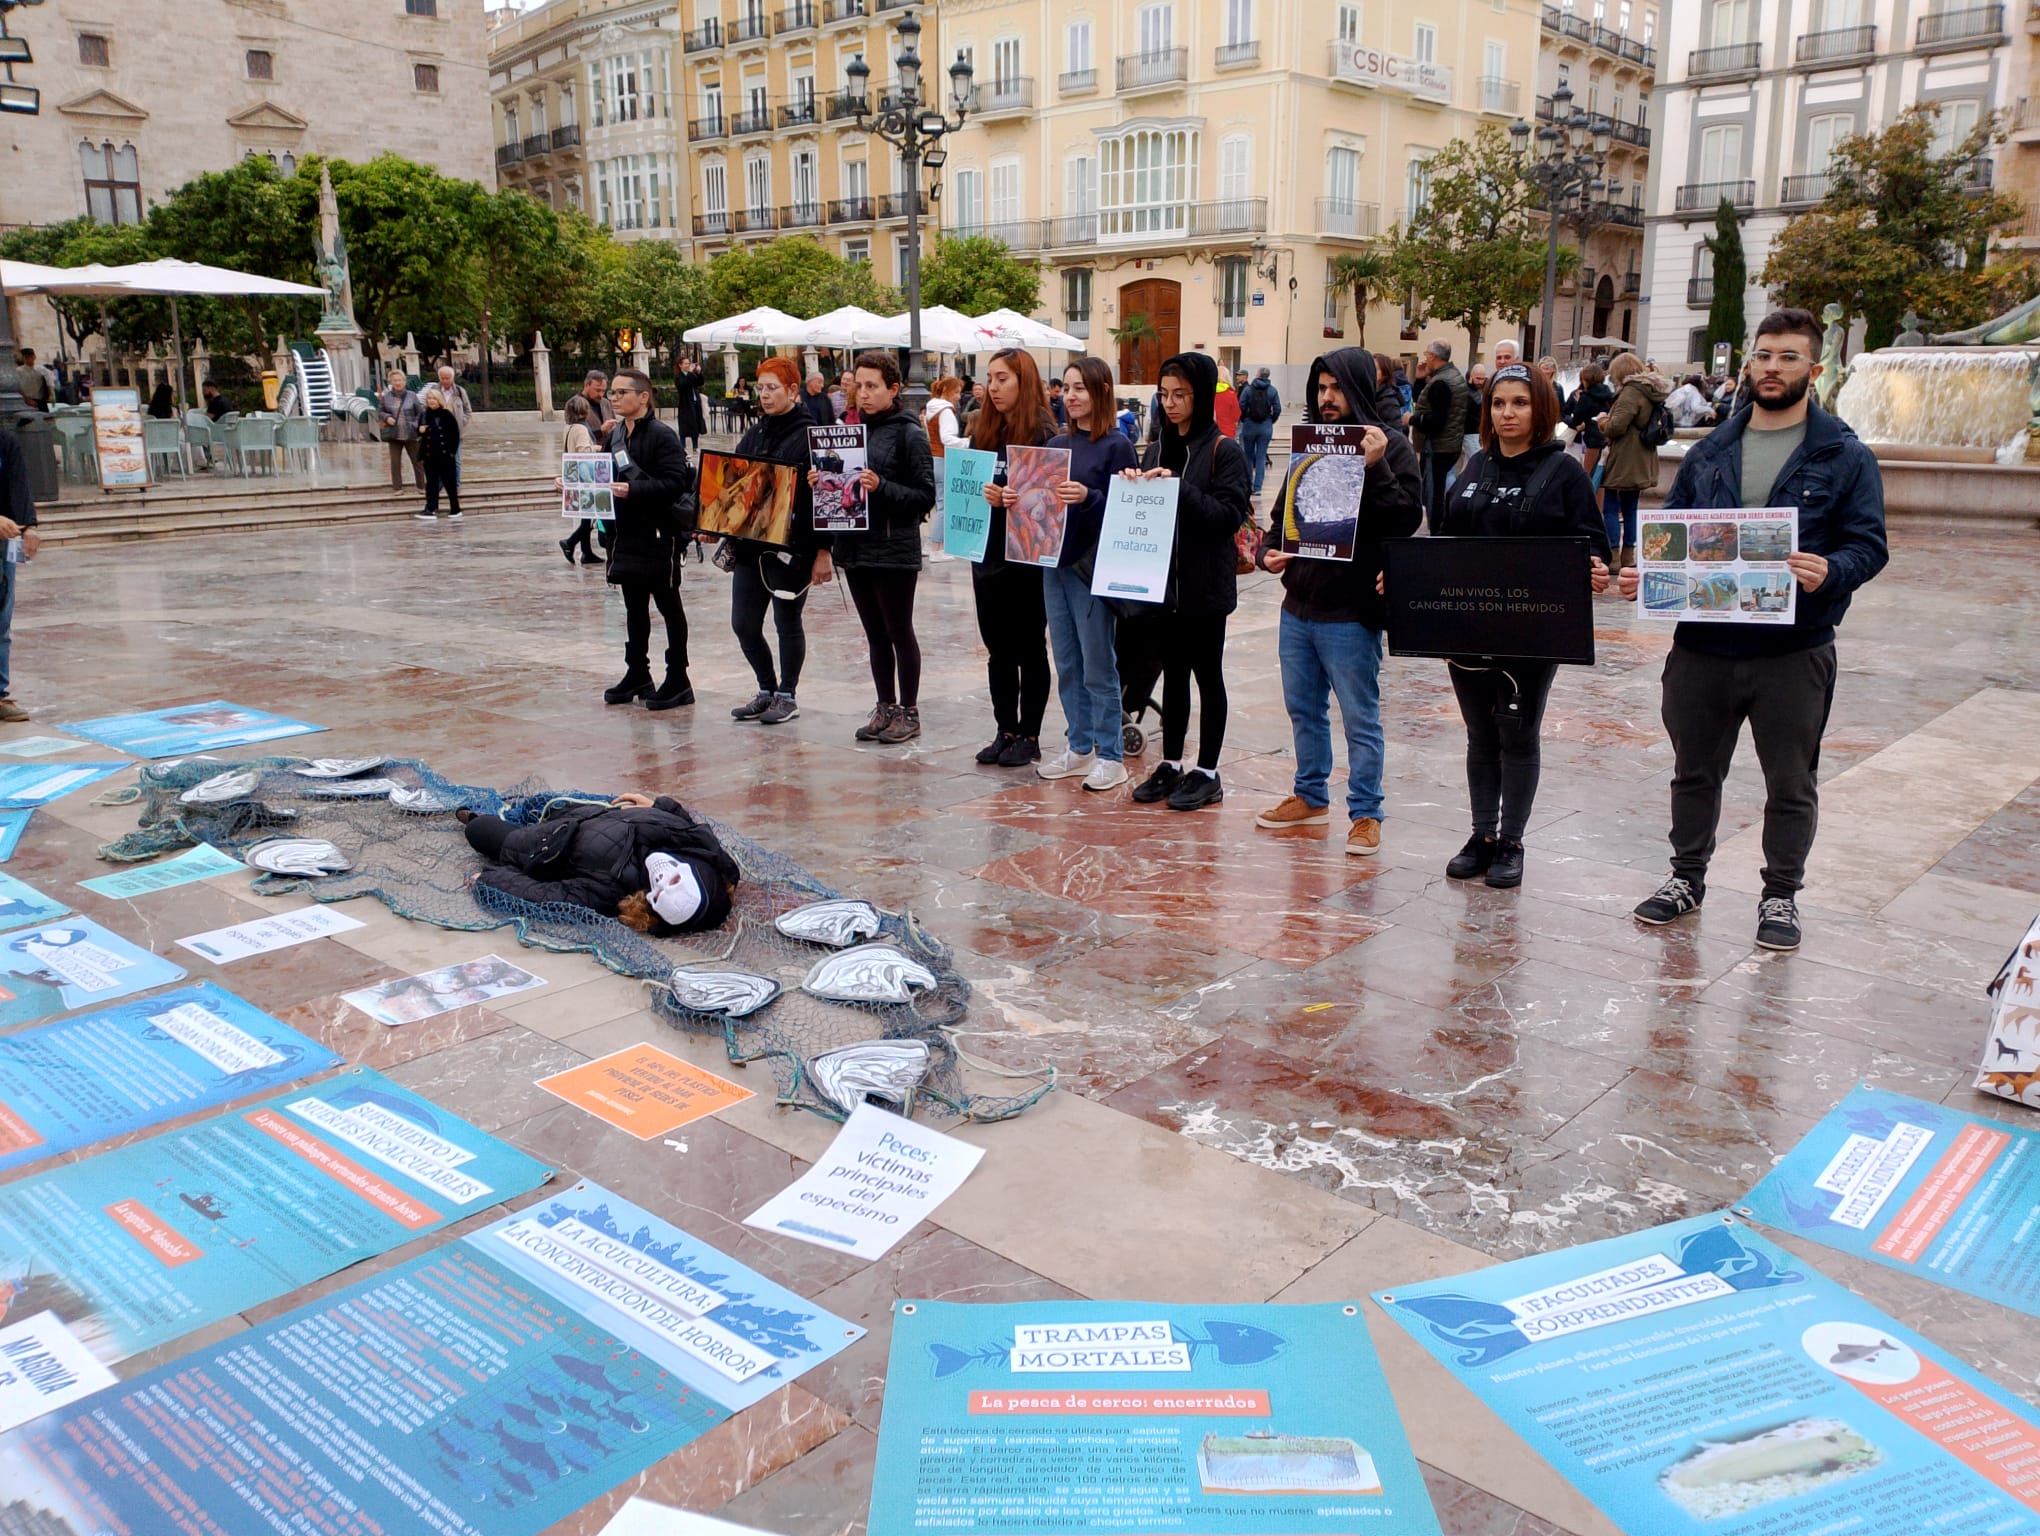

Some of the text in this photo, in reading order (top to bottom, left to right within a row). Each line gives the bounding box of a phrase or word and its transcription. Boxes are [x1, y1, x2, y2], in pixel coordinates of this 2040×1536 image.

[1354, 49, 1397, 78] CSIC
[811, 426, 861, 437] SON ALGUIEN
[1315, 425, 1345, 436] PESCA
[817, 436, 857, 448] NO ALGO
[1325, 436, 1335, 444] ES
[1304, 443, 1357, 455] ASESINATO
[961, 460, 976, 476] SOY
[951, 478, 983, 496] SENSIBLE
[965, 498, 970, 513] Y
[1121, 491, 1165, 507] La pesca
[1135, 510, 1147, 521] es
[950, 515, 984, 534] SINTIENTE
[1128, 526, 1148, 537] una
[1112, 539, 1159, 554] matanza
[1468, 587, 1504, 599] VIVOS,
[1507, 588, 1529, 598] LOS
[1408, 600, 1566, 613] CANGREJOS SON HERVIDOS
[352, 1104, 467, 1164] SUFRIMIENTO Y
[297, 1100, 481, 1198] MUERTES INCALCULABLES
[878, 1132, 939, 1166] Peces:
[856, 1150, 933, 1184] víctimas
[828, 1164, 929, 1200] principales
[848, 1187, 883, 1203] del
[800, 1191, 899, 1225] especismo
[557, 1222, 713, 1311] LA ACUICULTURA:
[1520, 1262, 1668, 1315] ¡FACULTADES
[503, 1223, 532, 1241] LA
[646, 1304, 690, 1334] DEL
[677, 1325, 757, 1376] HORROR
[1522, 1276, 1727, 1337] SORPRENDENTES!
[1022, 1325, 1167, 1344] TRAMPAS
[0, 1335, 80, 1396] MI AGONÍA
[1018, 1350, 1185, 1368] MORTALES
[980, 1394, 1257, 1412] La pesca de cerco: encerrados
[922, 1427, 947, 1435] Esta
[991, 1427, 1006, 1435] de
[1008, 1427, 1053, 1435] cercado
[1071, 1426, 1103, 1435] utiliza
[1105, 1428, 1130, 1436] para
[1132, 1427, 1181, 1436] capturas
[920, 1436, 1182, 1446] de superficie (sardinas, anchoas, arenques,
[972, 1446, 984, 1454] El
[990, 1446, 1022, 1454] barco
[1027, 1445, 1081, 1455] despliega
[1115, 1445, 1134, 1454] red
[1139, 1445, 1183, 1455] vertical,
[919, 1456, 966, 1465] giratoria
[1087, 1455, 1102, 1464] de
[1105, 1456, 1140, 1464] varios
[919, 1466, 941, 1474] tros
[947, 1466, 962, 1474] de
[1025, 1465, 1079, 1474] alrededor
[1086, 1465, 1101, 1474] de
[1107, 1466, 1122, 1474] un
[1129, 1465, 1165, 1474] banco
[1171, 1465, 1186, 1473] de
[951, 1497, 967, 1505] en
[970, 1496, 1025, 1505] salmuera
[1070, 1497, 1099, 1506] cuya
[1102, 1496, 1174, 1506] temperatura
[1176, 1497, 1192, 1505] se
